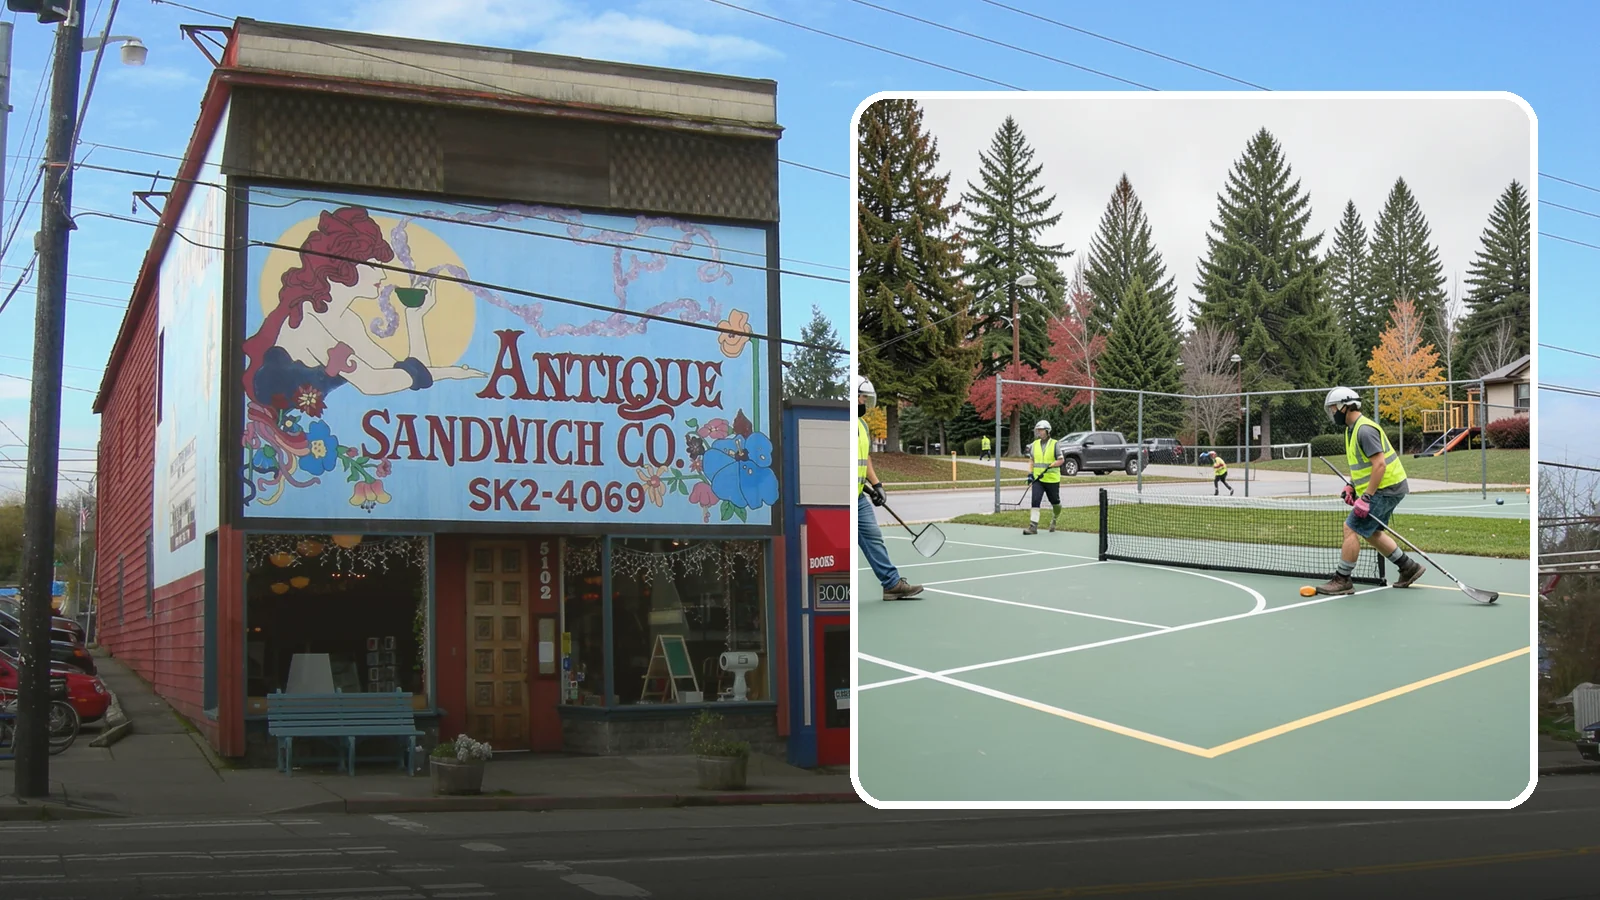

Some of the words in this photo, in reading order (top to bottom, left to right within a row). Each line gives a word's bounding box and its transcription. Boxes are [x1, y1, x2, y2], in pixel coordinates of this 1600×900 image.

[476, 329, 723, 420] ANTIQUE
[362, 410, 605, 468] SANDWICH
[617, 422, 685, 469] CO.
[468, 478, 646, 514] SK2-4069
[540, 541, 551, 600] 5102
[809, 555, 835, 569] BOOKS
